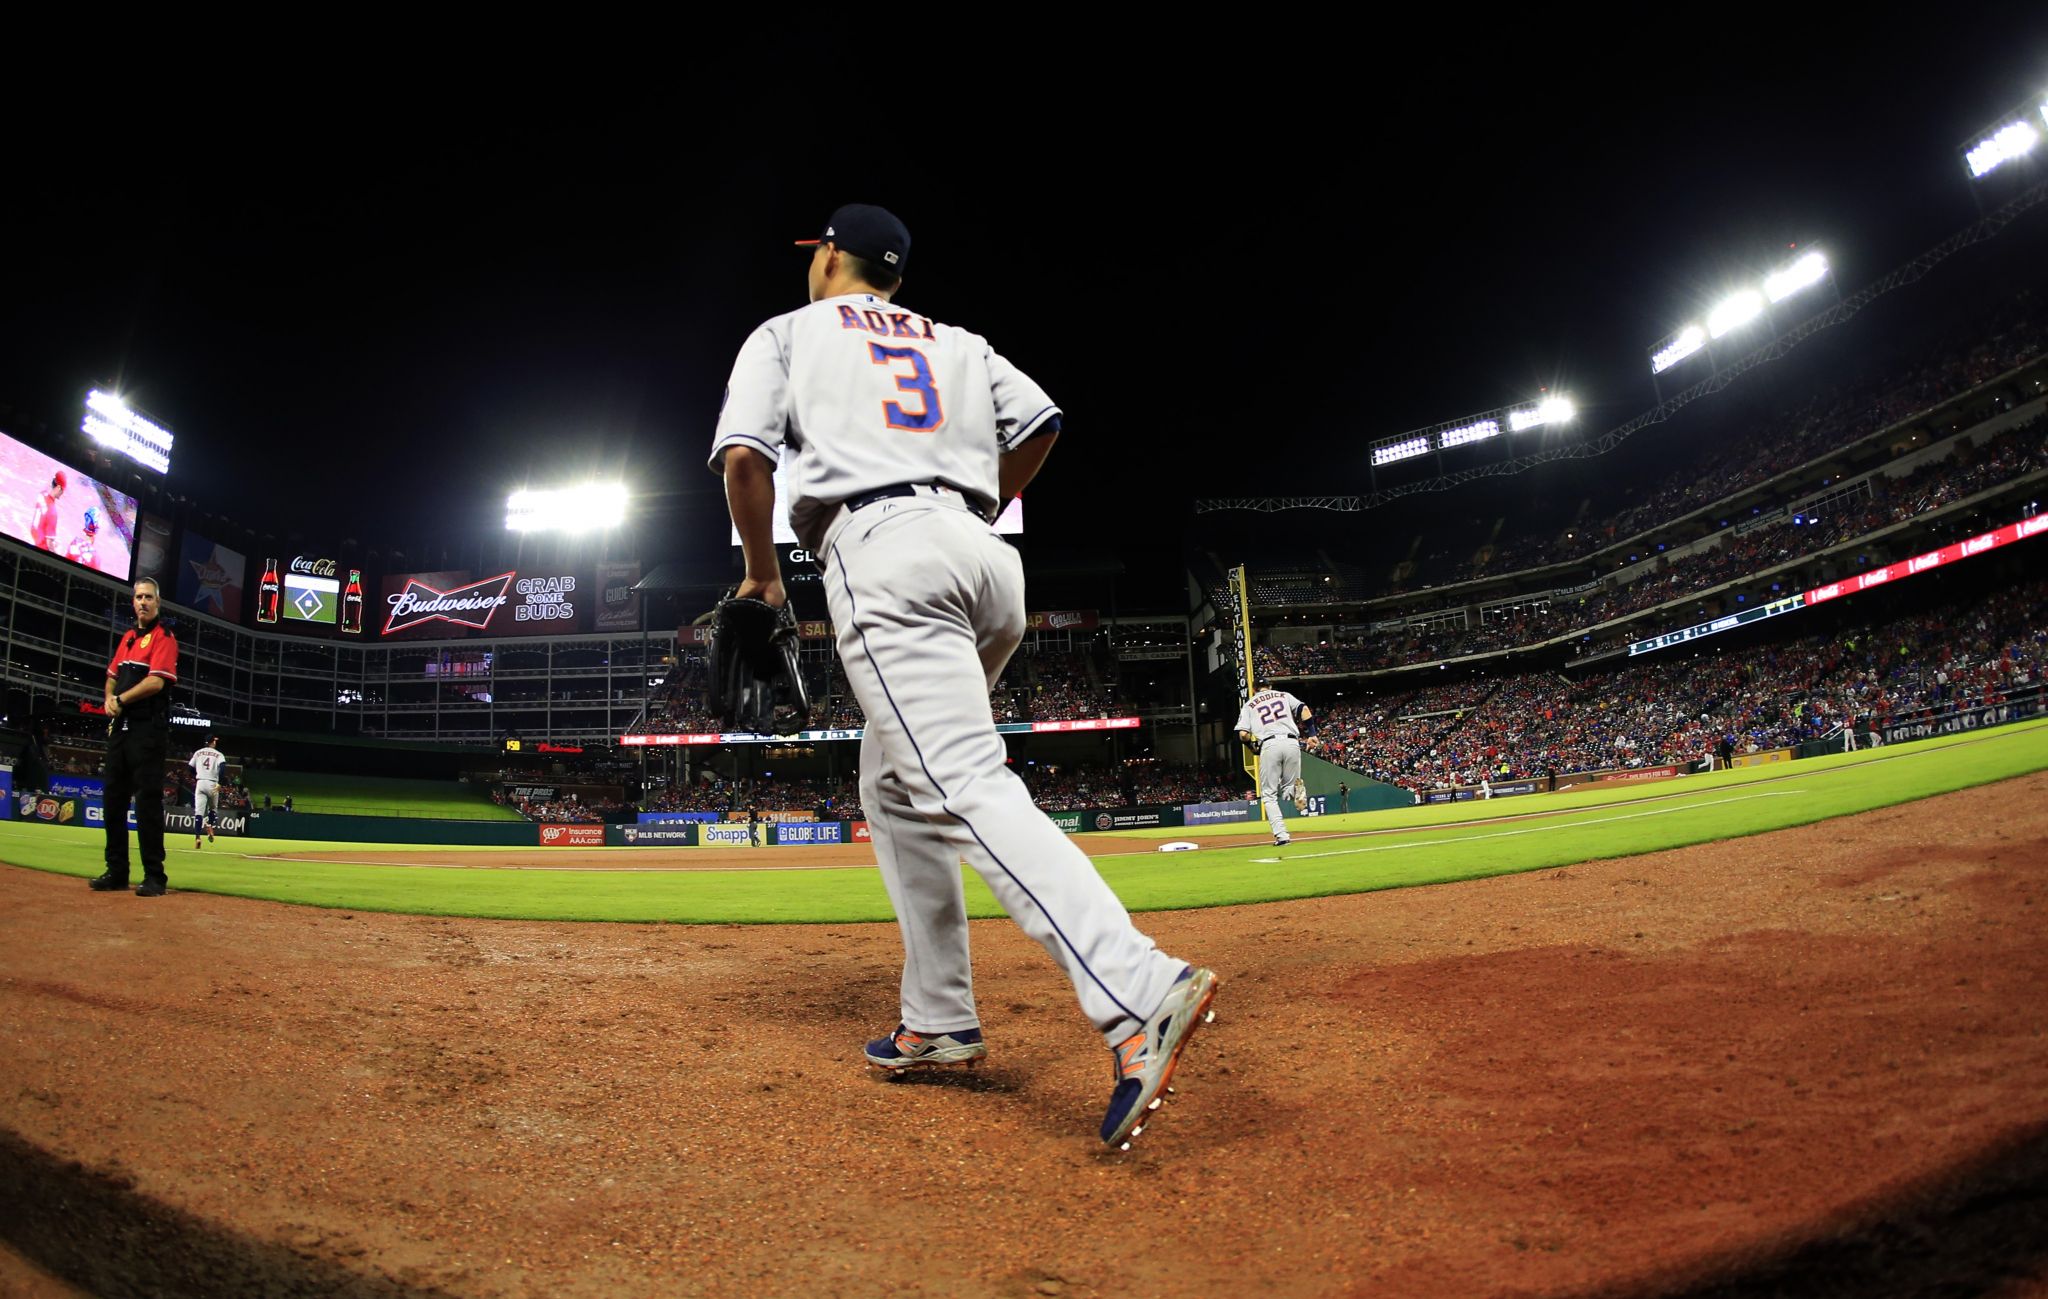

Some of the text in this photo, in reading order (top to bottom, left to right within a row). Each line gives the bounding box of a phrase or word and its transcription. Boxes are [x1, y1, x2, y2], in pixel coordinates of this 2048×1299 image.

[837, 304, 936, 342] AOKI
[867, 340, 944, 432] 3
[516, 576, 576, 595] GRAB
[388, 591, 506, 616] Budweiser
[526, 592, 564, 605] SOME
[515, 602, 573, 621] BUDS
[1248, 692, 1286, 709] REDDICK
[1257, 700, 1288, 726] 22
[172, 716, 211, 728] HYUNDAI
[203, 757, 210, 770] 4
[41, 803, 57, 814] DQ
[1211, 810, 1221, 818] City
[1137, 814, 1159, 822] JOHN'S
[569, 827, 602, 836] Insurance
[653, 831, 687, 839] NETWORK
[788, 826, 839, 841] GLOBE LIFE
